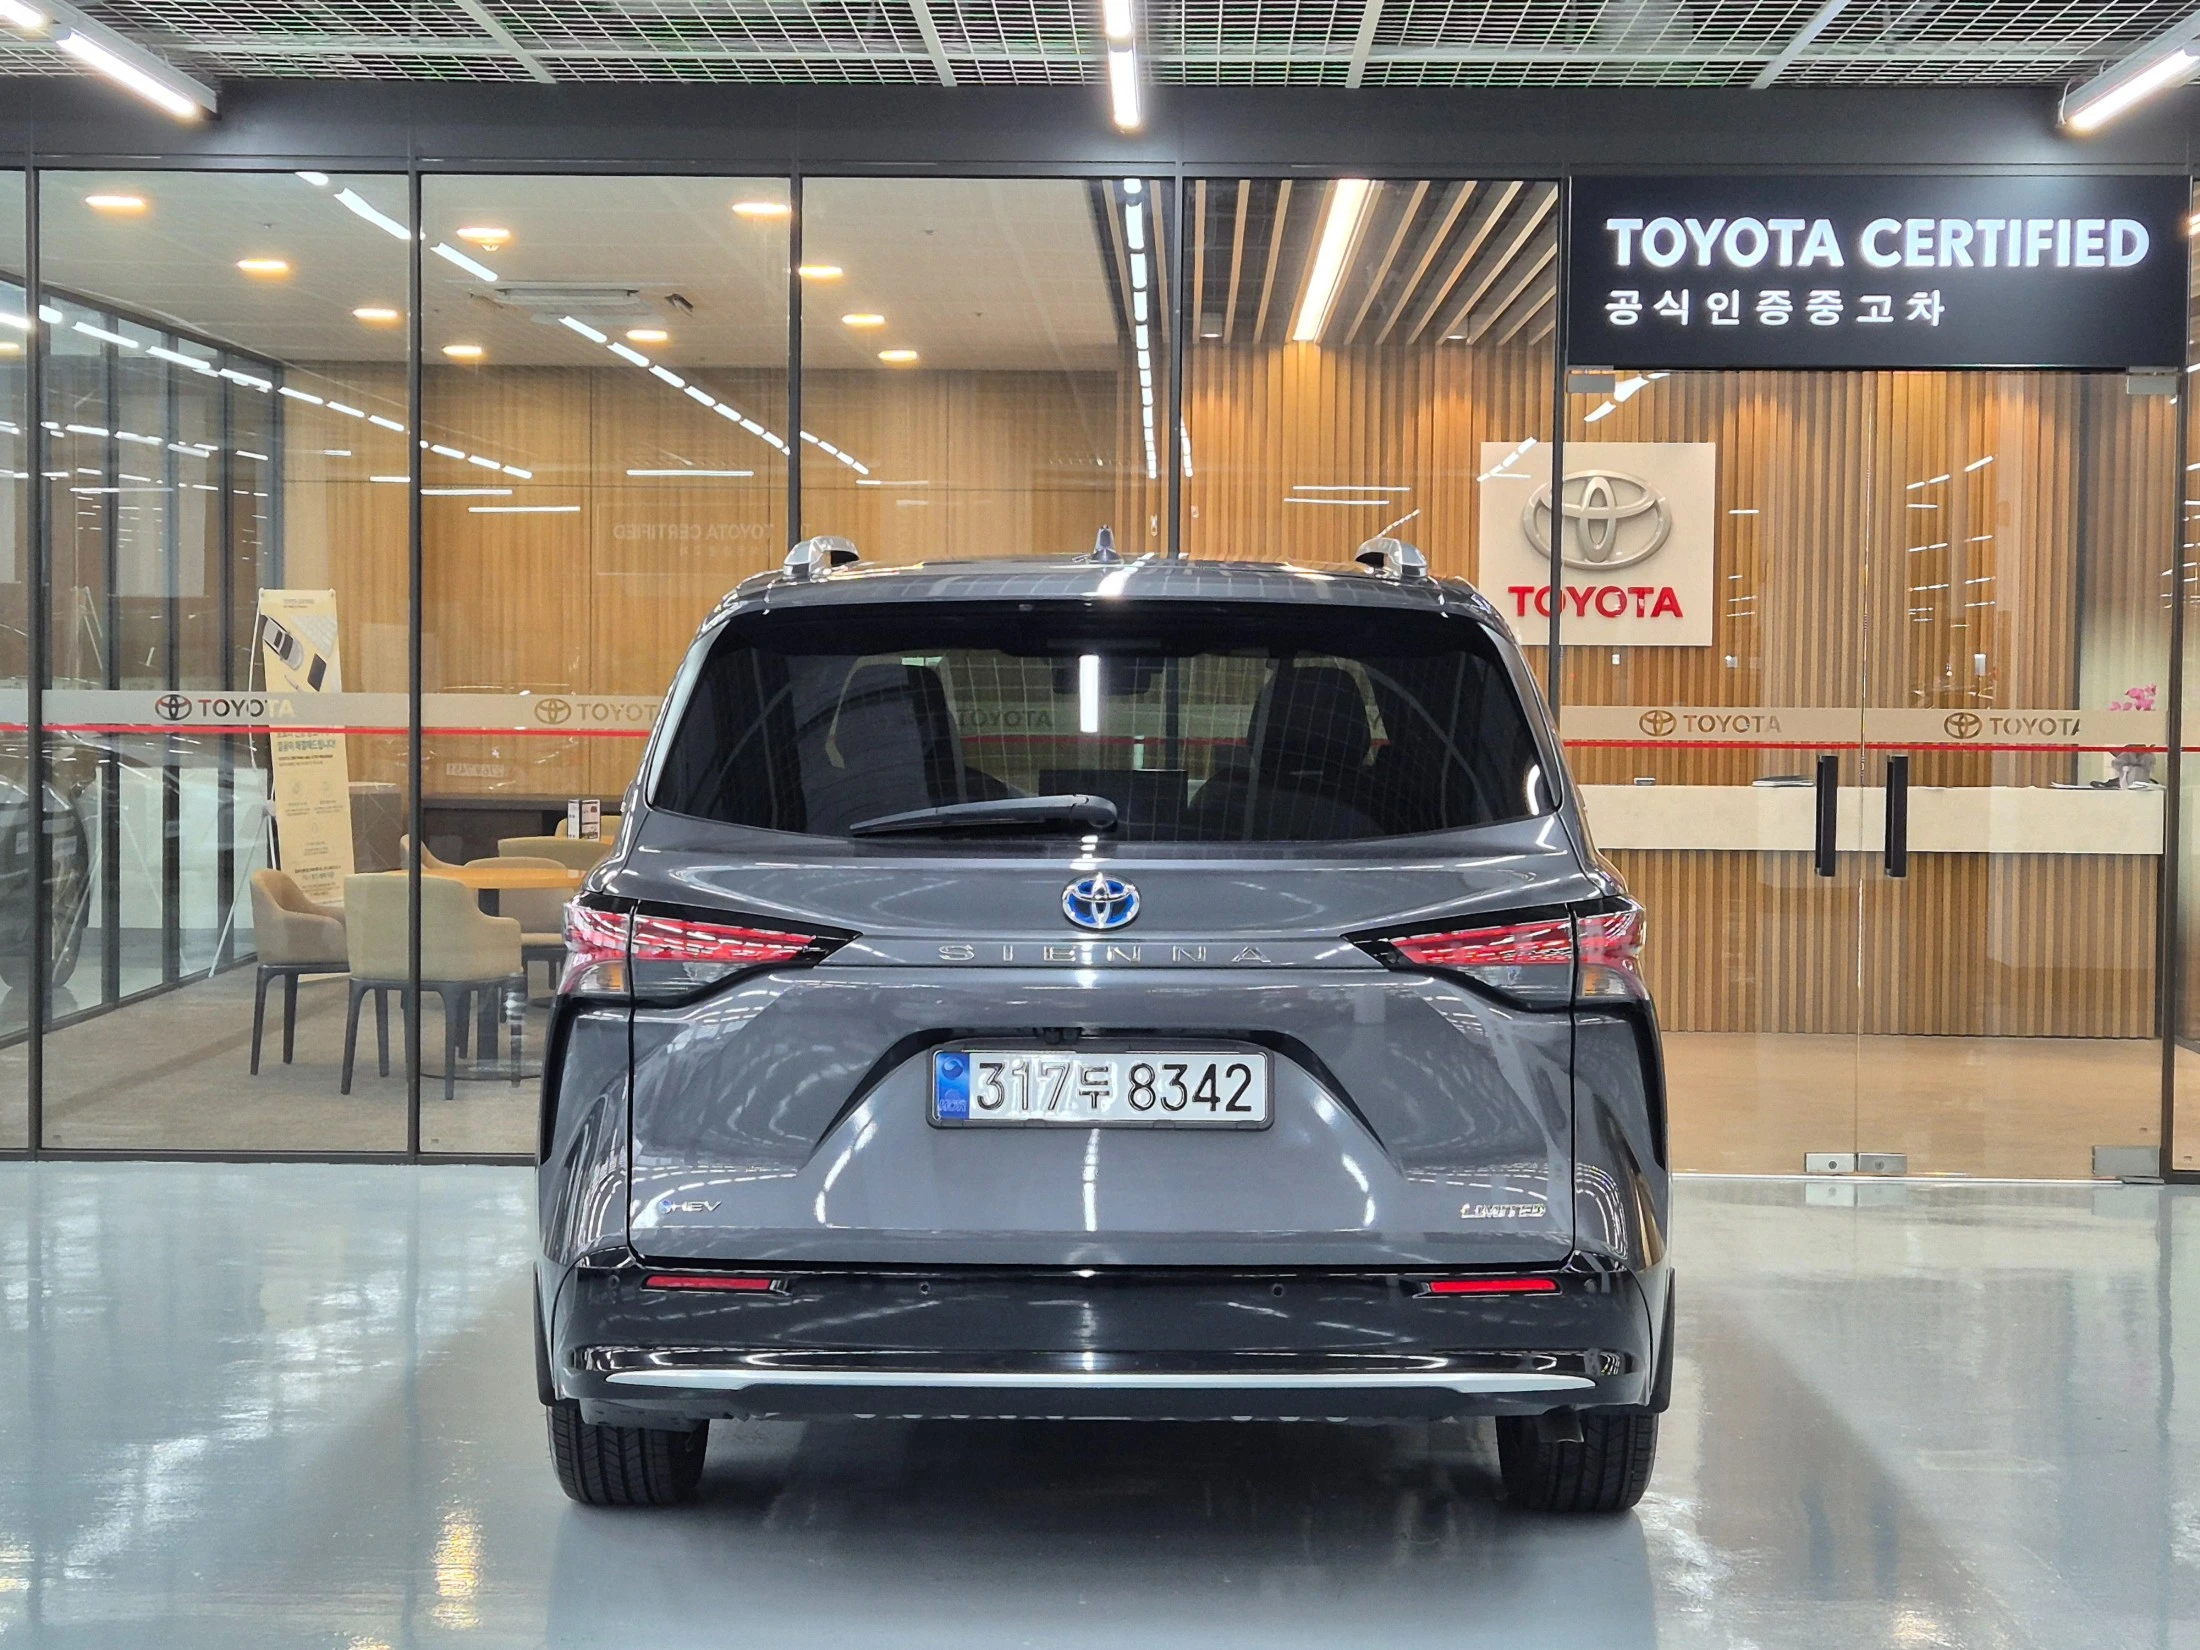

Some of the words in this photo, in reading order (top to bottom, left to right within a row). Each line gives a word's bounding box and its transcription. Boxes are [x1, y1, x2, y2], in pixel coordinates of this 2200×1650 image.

[1605, 216, 1845, 269] TOYOTA
[1860, 217, 2151, 269] CERTIFIED
[1604, 289, 1946, 328] 공식인증중고차
[1508, 585, 1684, 619] TOYOTA
[198, 699, 296, 718] TOYOTA
[577, 702, 659, 722] TOYOT
[1683, 714, 1782, 733] TOYOTA
[938, 944, 1271, 963] SIENNA
[976, 1062, 1110, 1111] 317두
[1128, 1063, 1252, 1112] 8342
